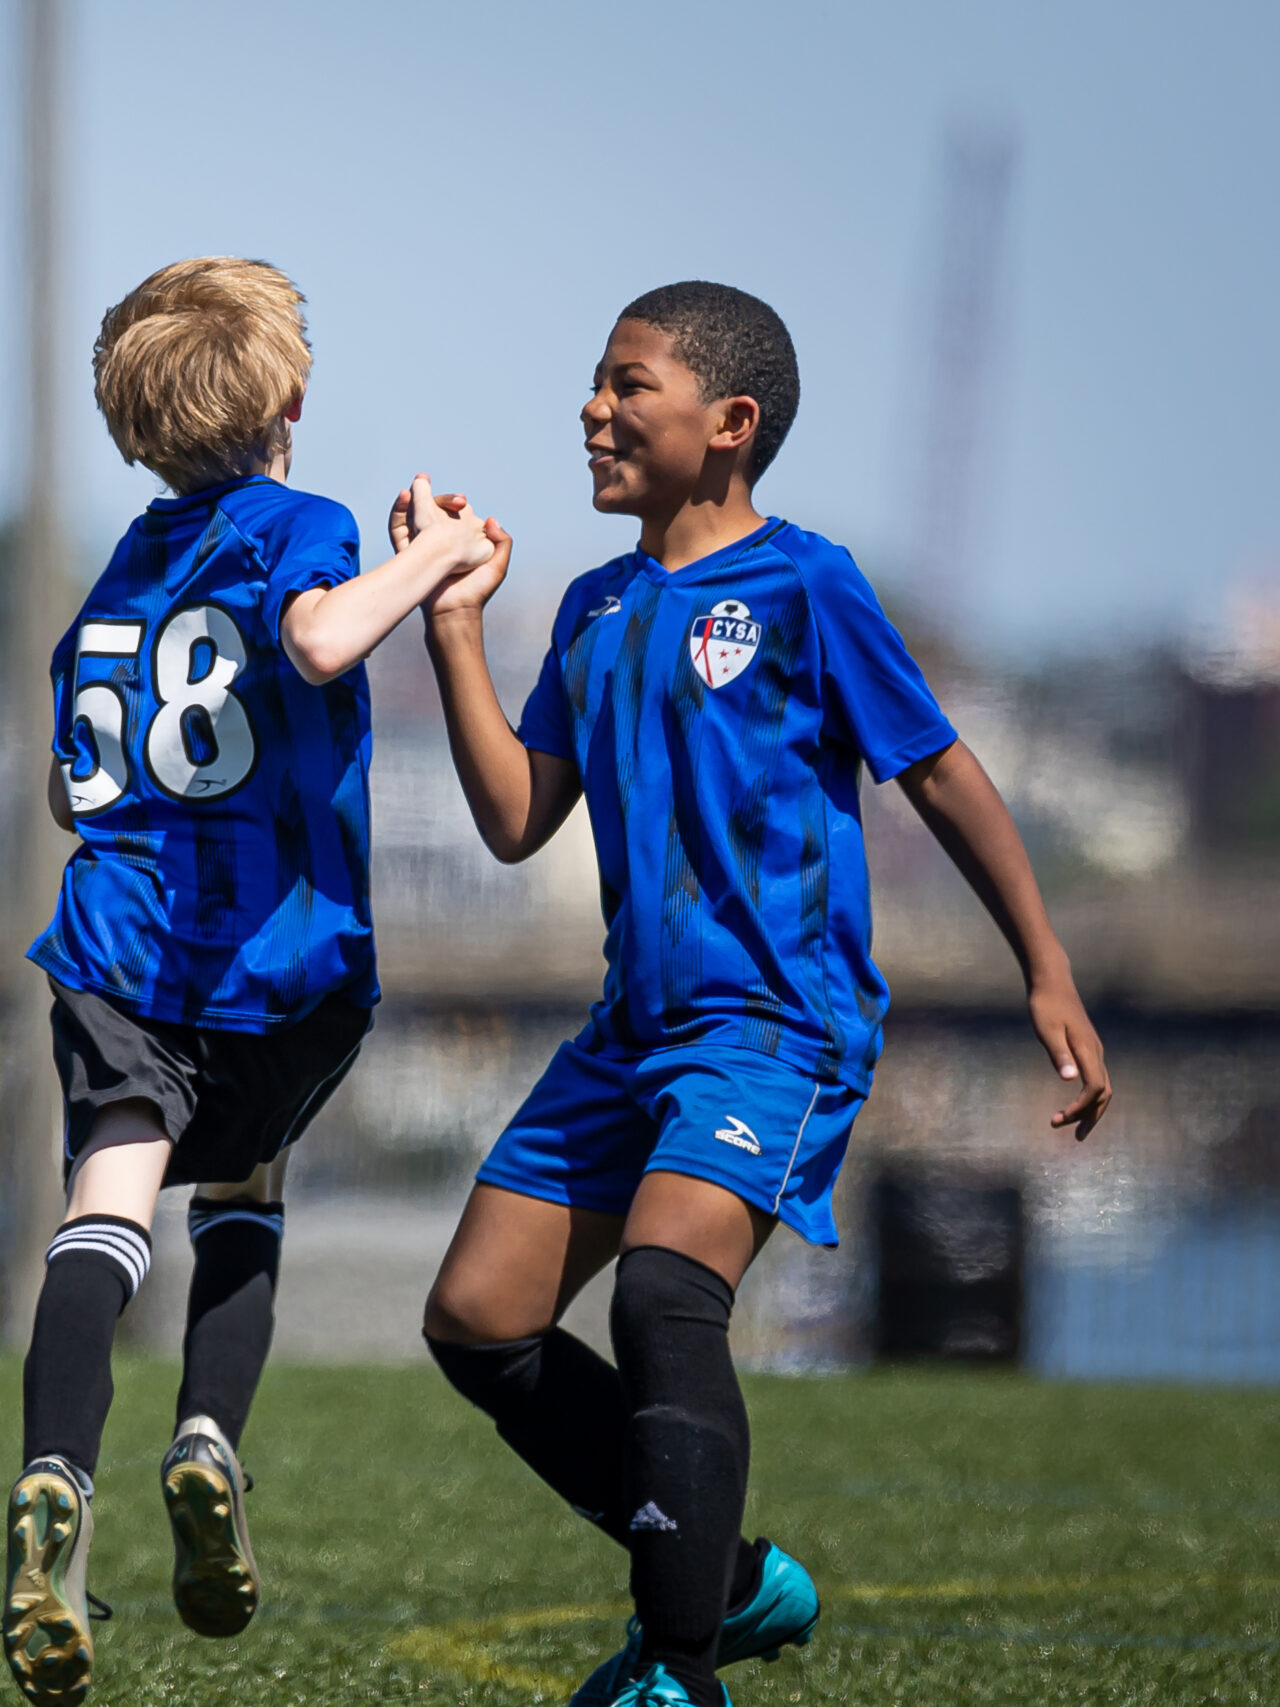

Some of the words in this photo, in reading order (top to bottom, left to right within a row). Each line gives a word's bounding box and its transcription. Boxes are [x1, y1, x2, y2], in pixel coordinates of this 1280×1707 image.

[712, 619, 757, 642] CYSA
[61, 600, 260, 817] 58
[715, 1131, 761, 1155] SCORE
